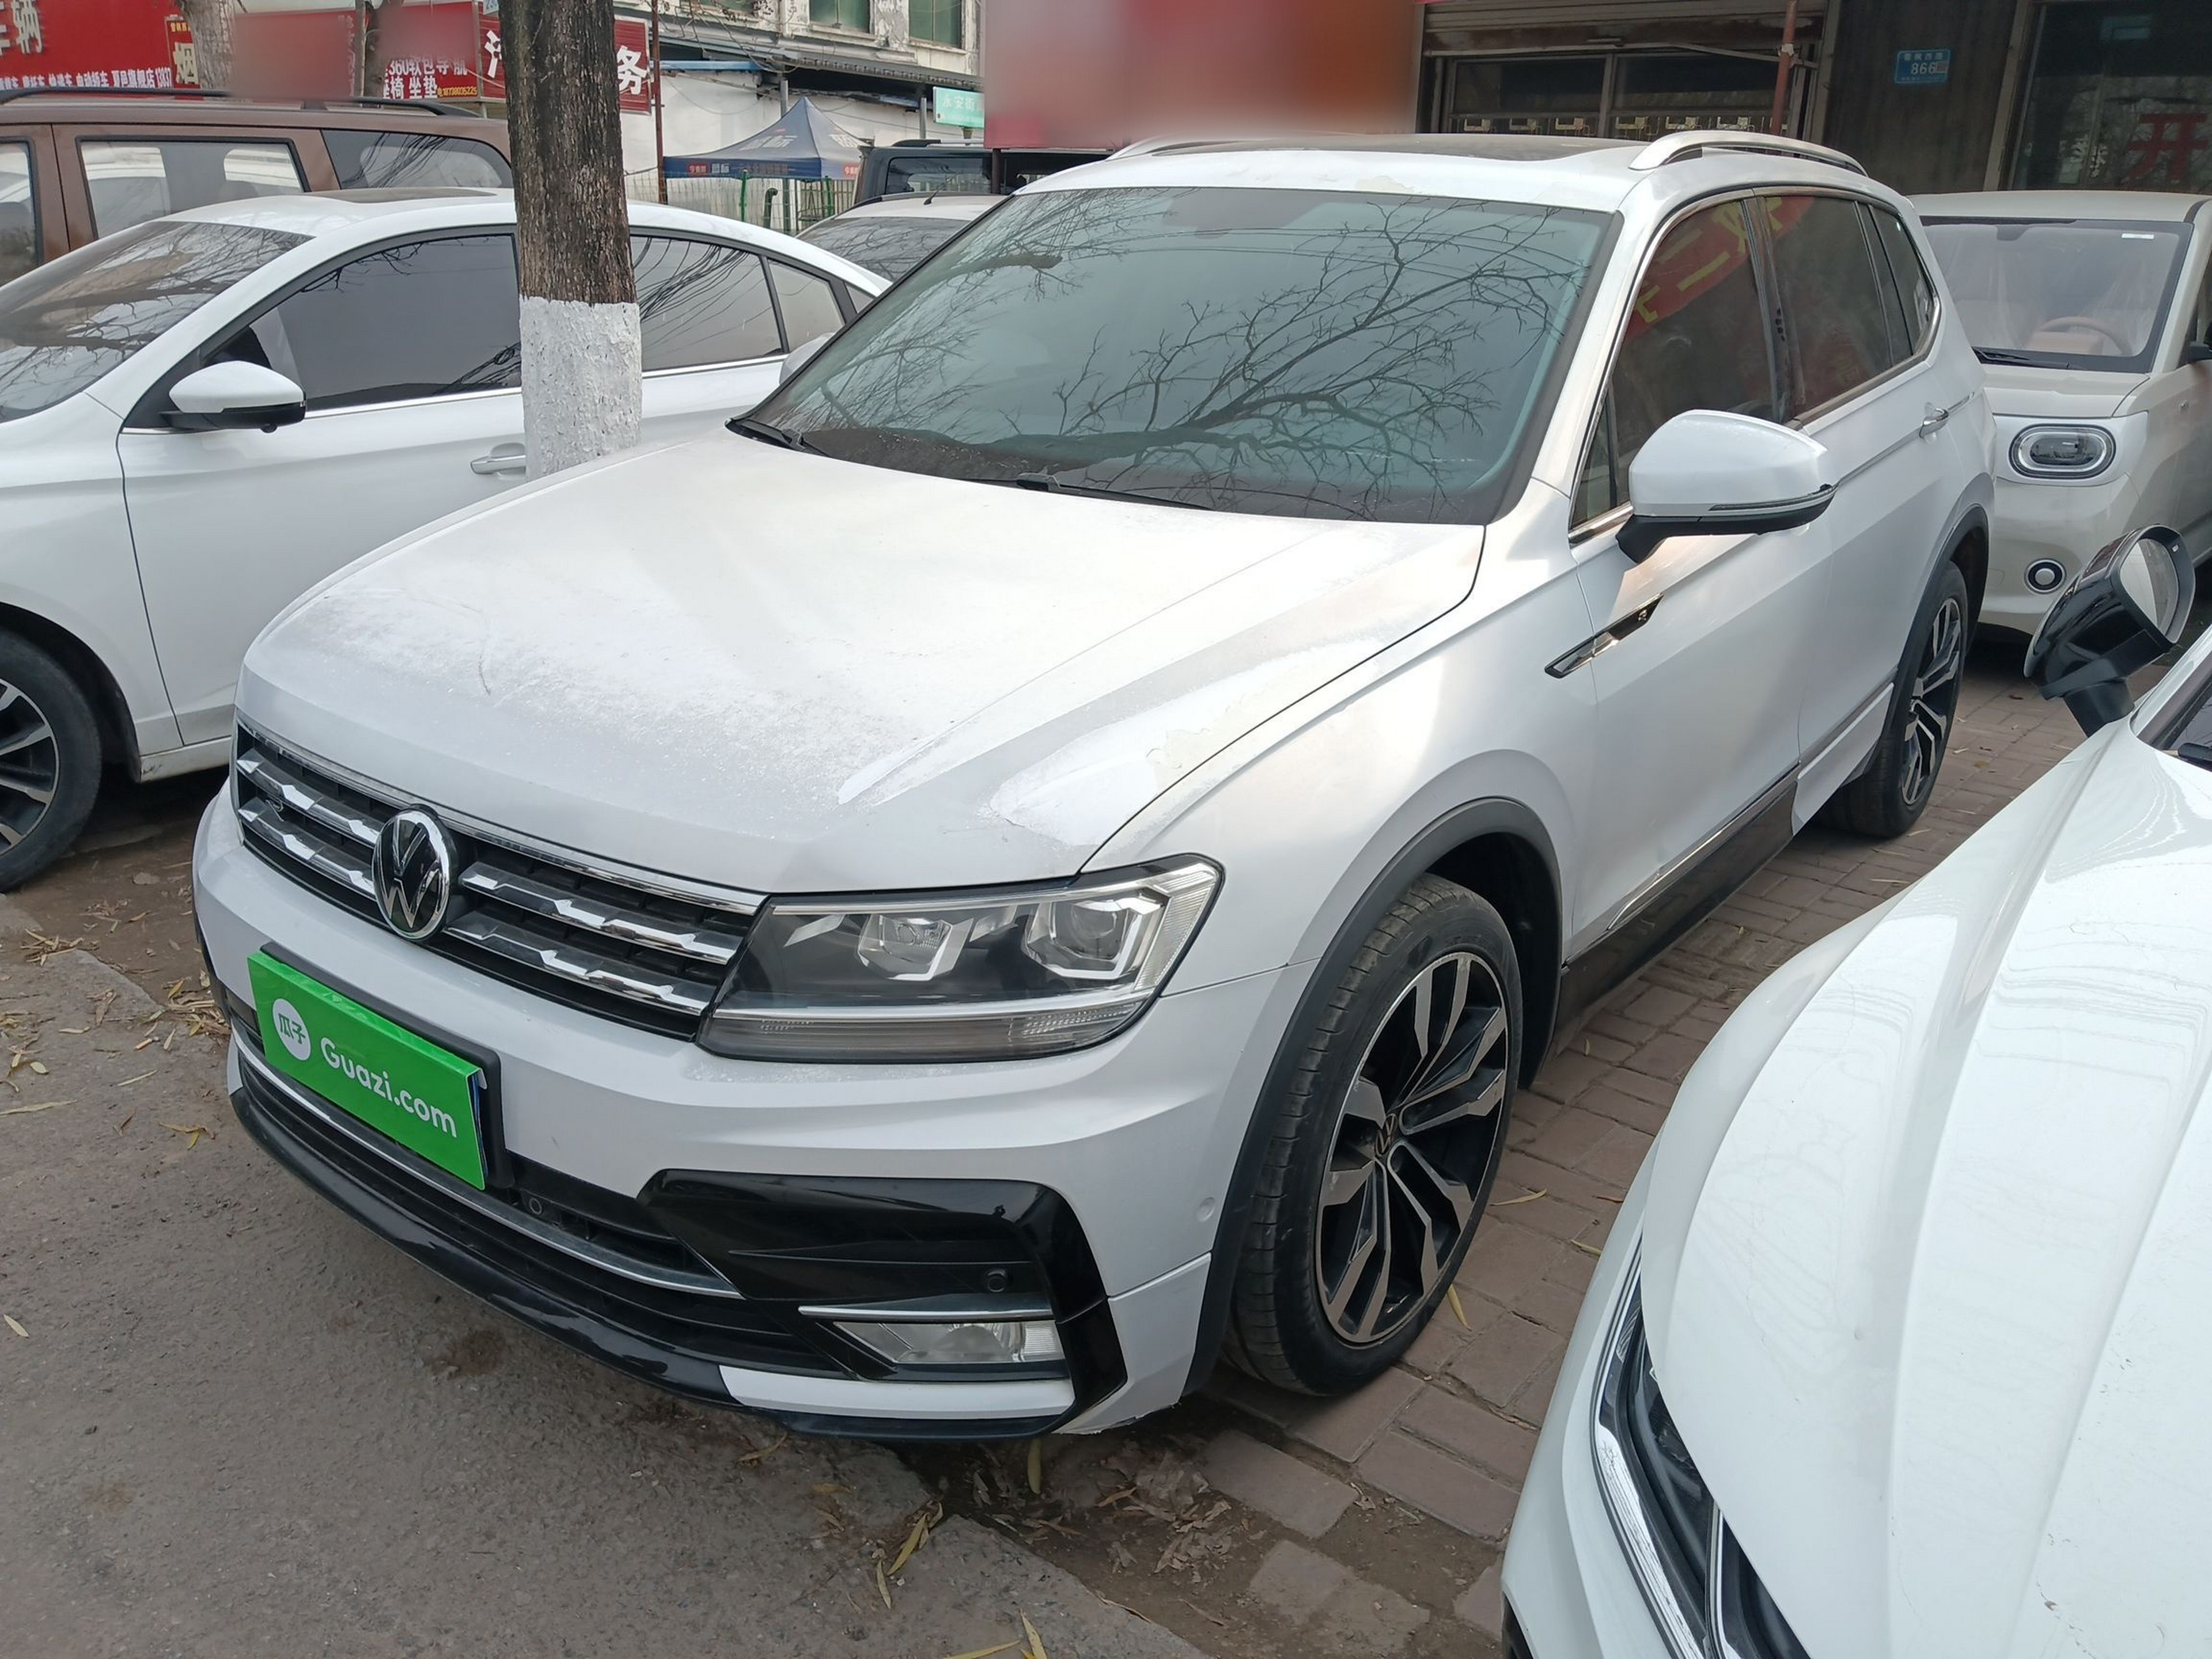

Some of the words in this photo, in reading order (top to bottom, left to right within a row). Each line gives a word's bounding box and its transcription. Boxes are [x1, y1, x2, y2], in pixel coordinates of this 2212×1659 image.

[1911, 62, 1936, 75] 866
[409, 75, 437, 99] 坐垫
[277, 1013, 306, 1046] 瓜子
[320, 1037, 457, 1138] Guazi.com
